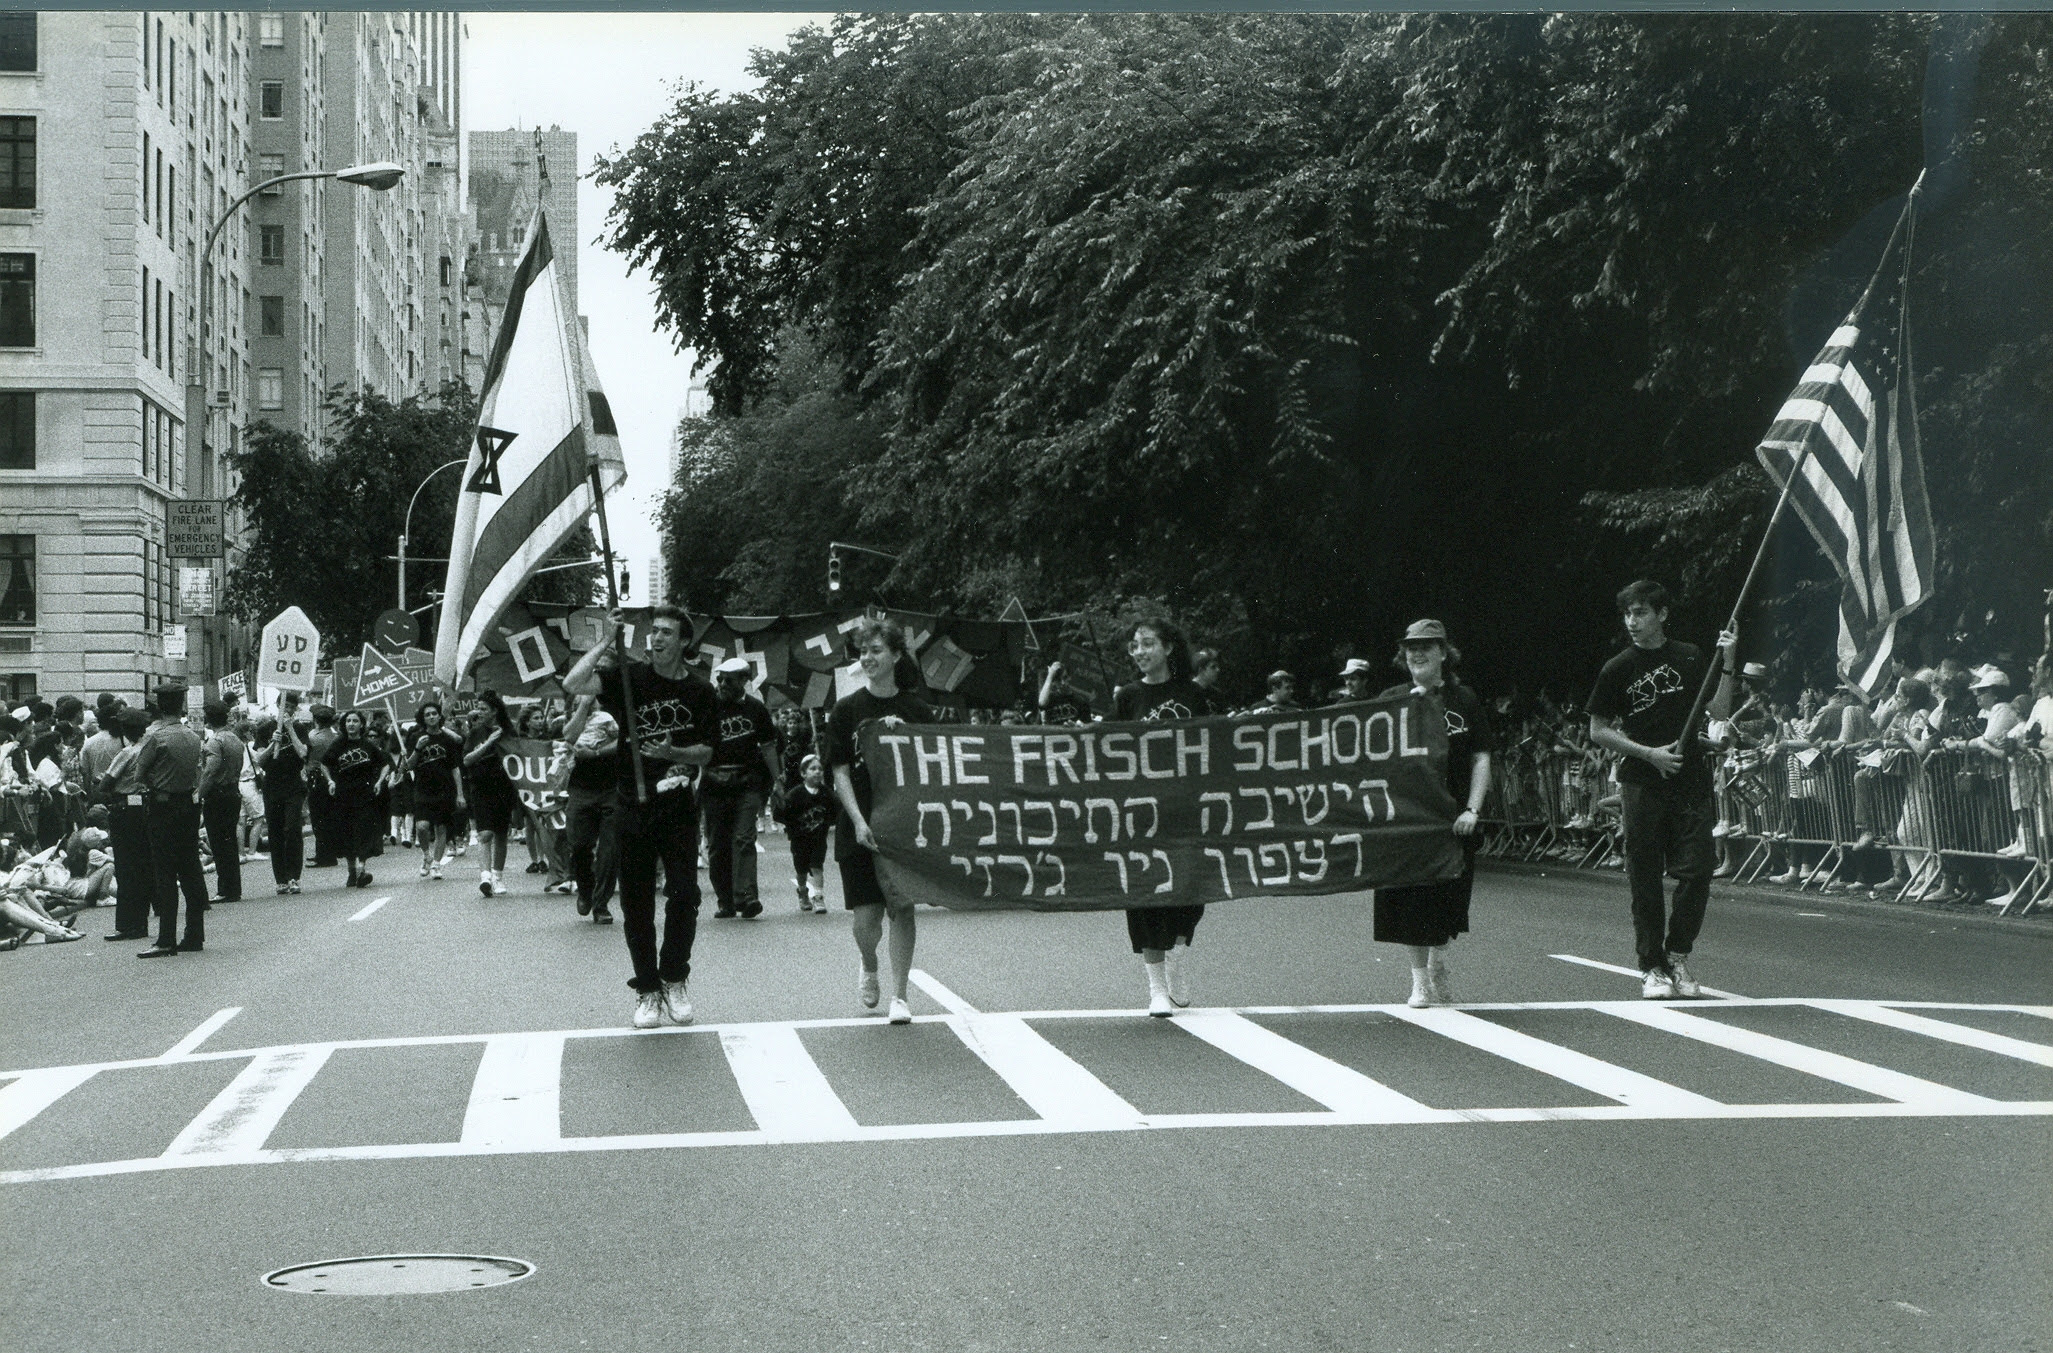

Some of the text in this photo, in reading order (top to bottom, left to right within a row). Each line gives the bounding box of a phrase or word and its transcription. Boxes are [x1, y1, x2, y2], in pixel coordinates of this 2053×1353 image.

[178, 505, 212, 514] CLEAR
[172, 516, 217, 525] FIRE LANE
[169, 534, 220, 543] EMERGENCY
[174, 544, 217, 554] VEHICLES
[275, 660, 301, 675] GO
[222, 672, 244, 690] PEACE
[360, 673, 399, 696] HOME
[408, 690, 425, 704] 37
[879, 706, 1429, 787] THE FRISCH SCHOOL
[915, 779, 1396, 849] הישיבה התיכונית
[1103, 848, 1174, 894] ניו
[1203, 833, 1364, 899] דצפון
